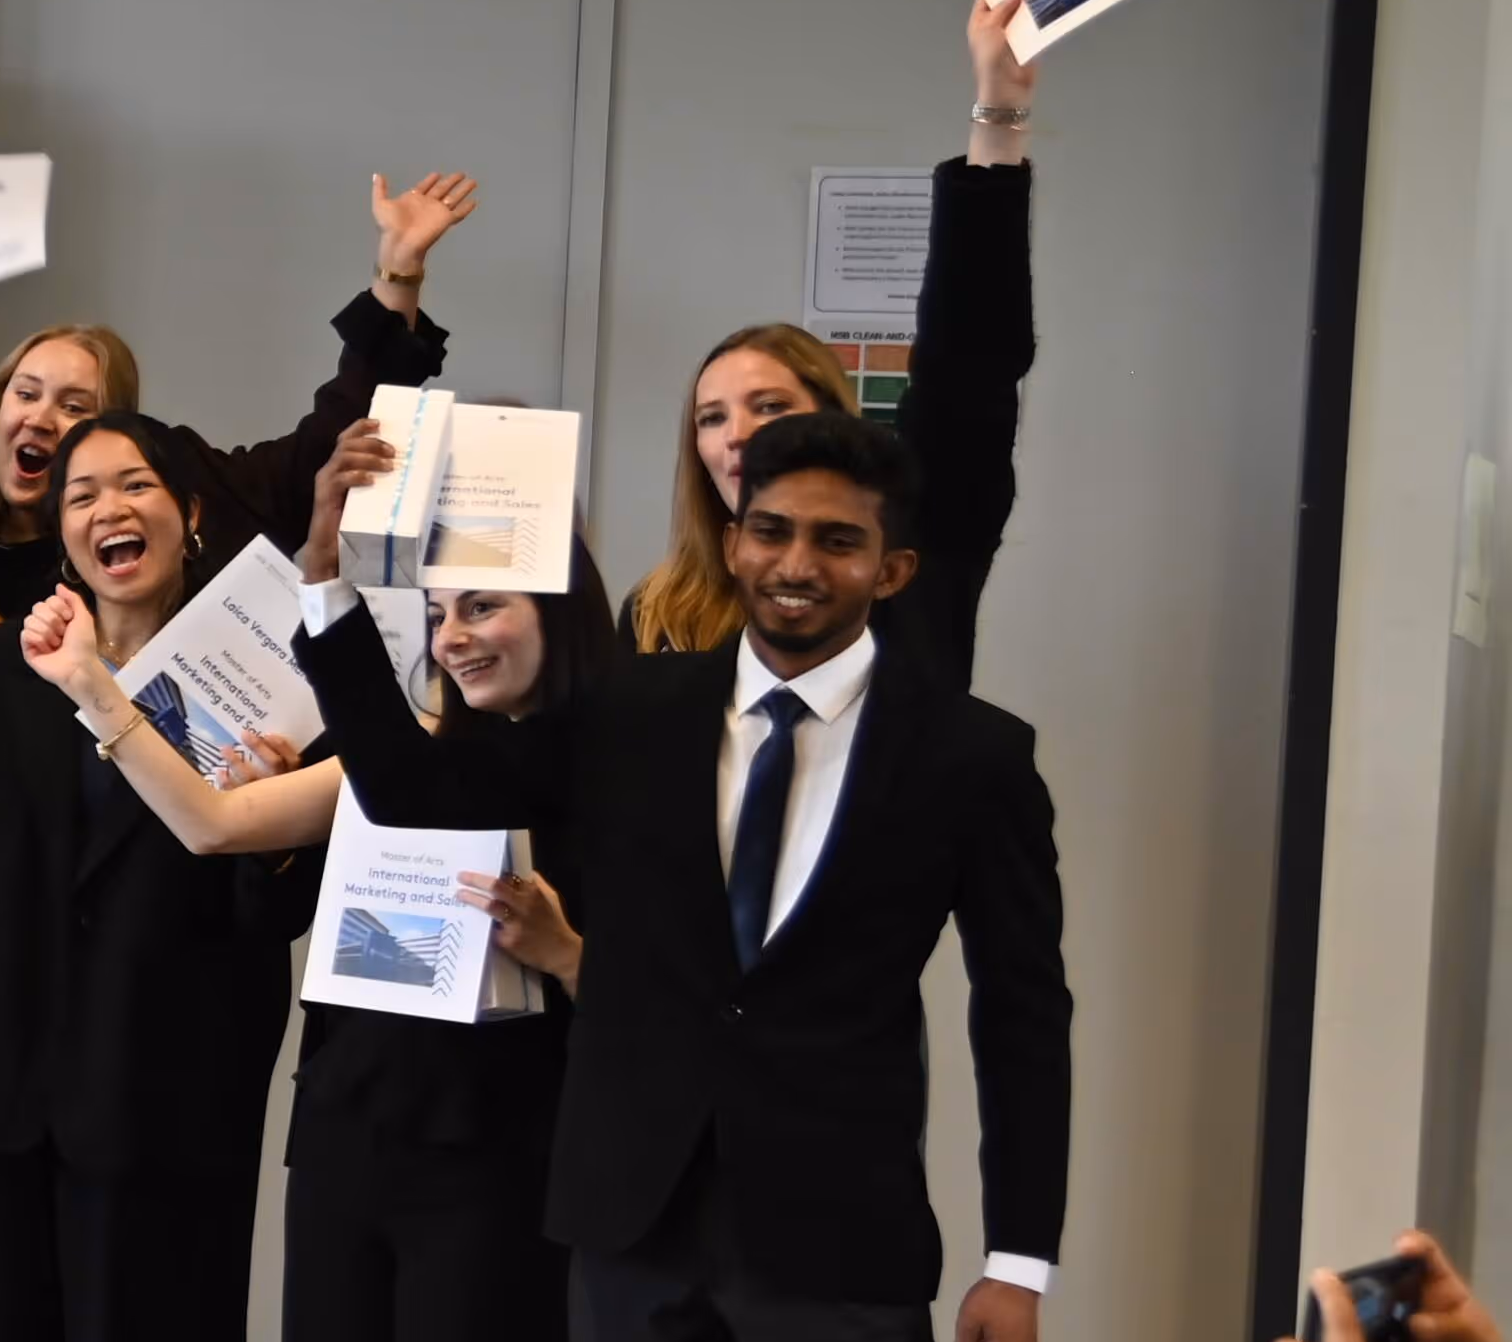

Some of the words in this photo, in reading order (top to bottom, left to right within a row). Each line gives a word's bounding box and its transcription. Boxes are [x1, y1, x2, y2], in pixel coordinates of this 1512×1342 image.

[222, 595, 250, 625] Laica
[250, 620, 287, 660] Vergara
[171, 652, 223, 706] Marketing
[222, 701, 245, 728] and
[242, 721, 265, 740] Sal
[199, 654, 268, 720] International
[221, 649, 247, 677] Master
[255, 682, 272, 701] Arts
[344, 883, 406, 904] Marketing
[410, 893, 434, 904] and
[368, 867, 450, 887] International
